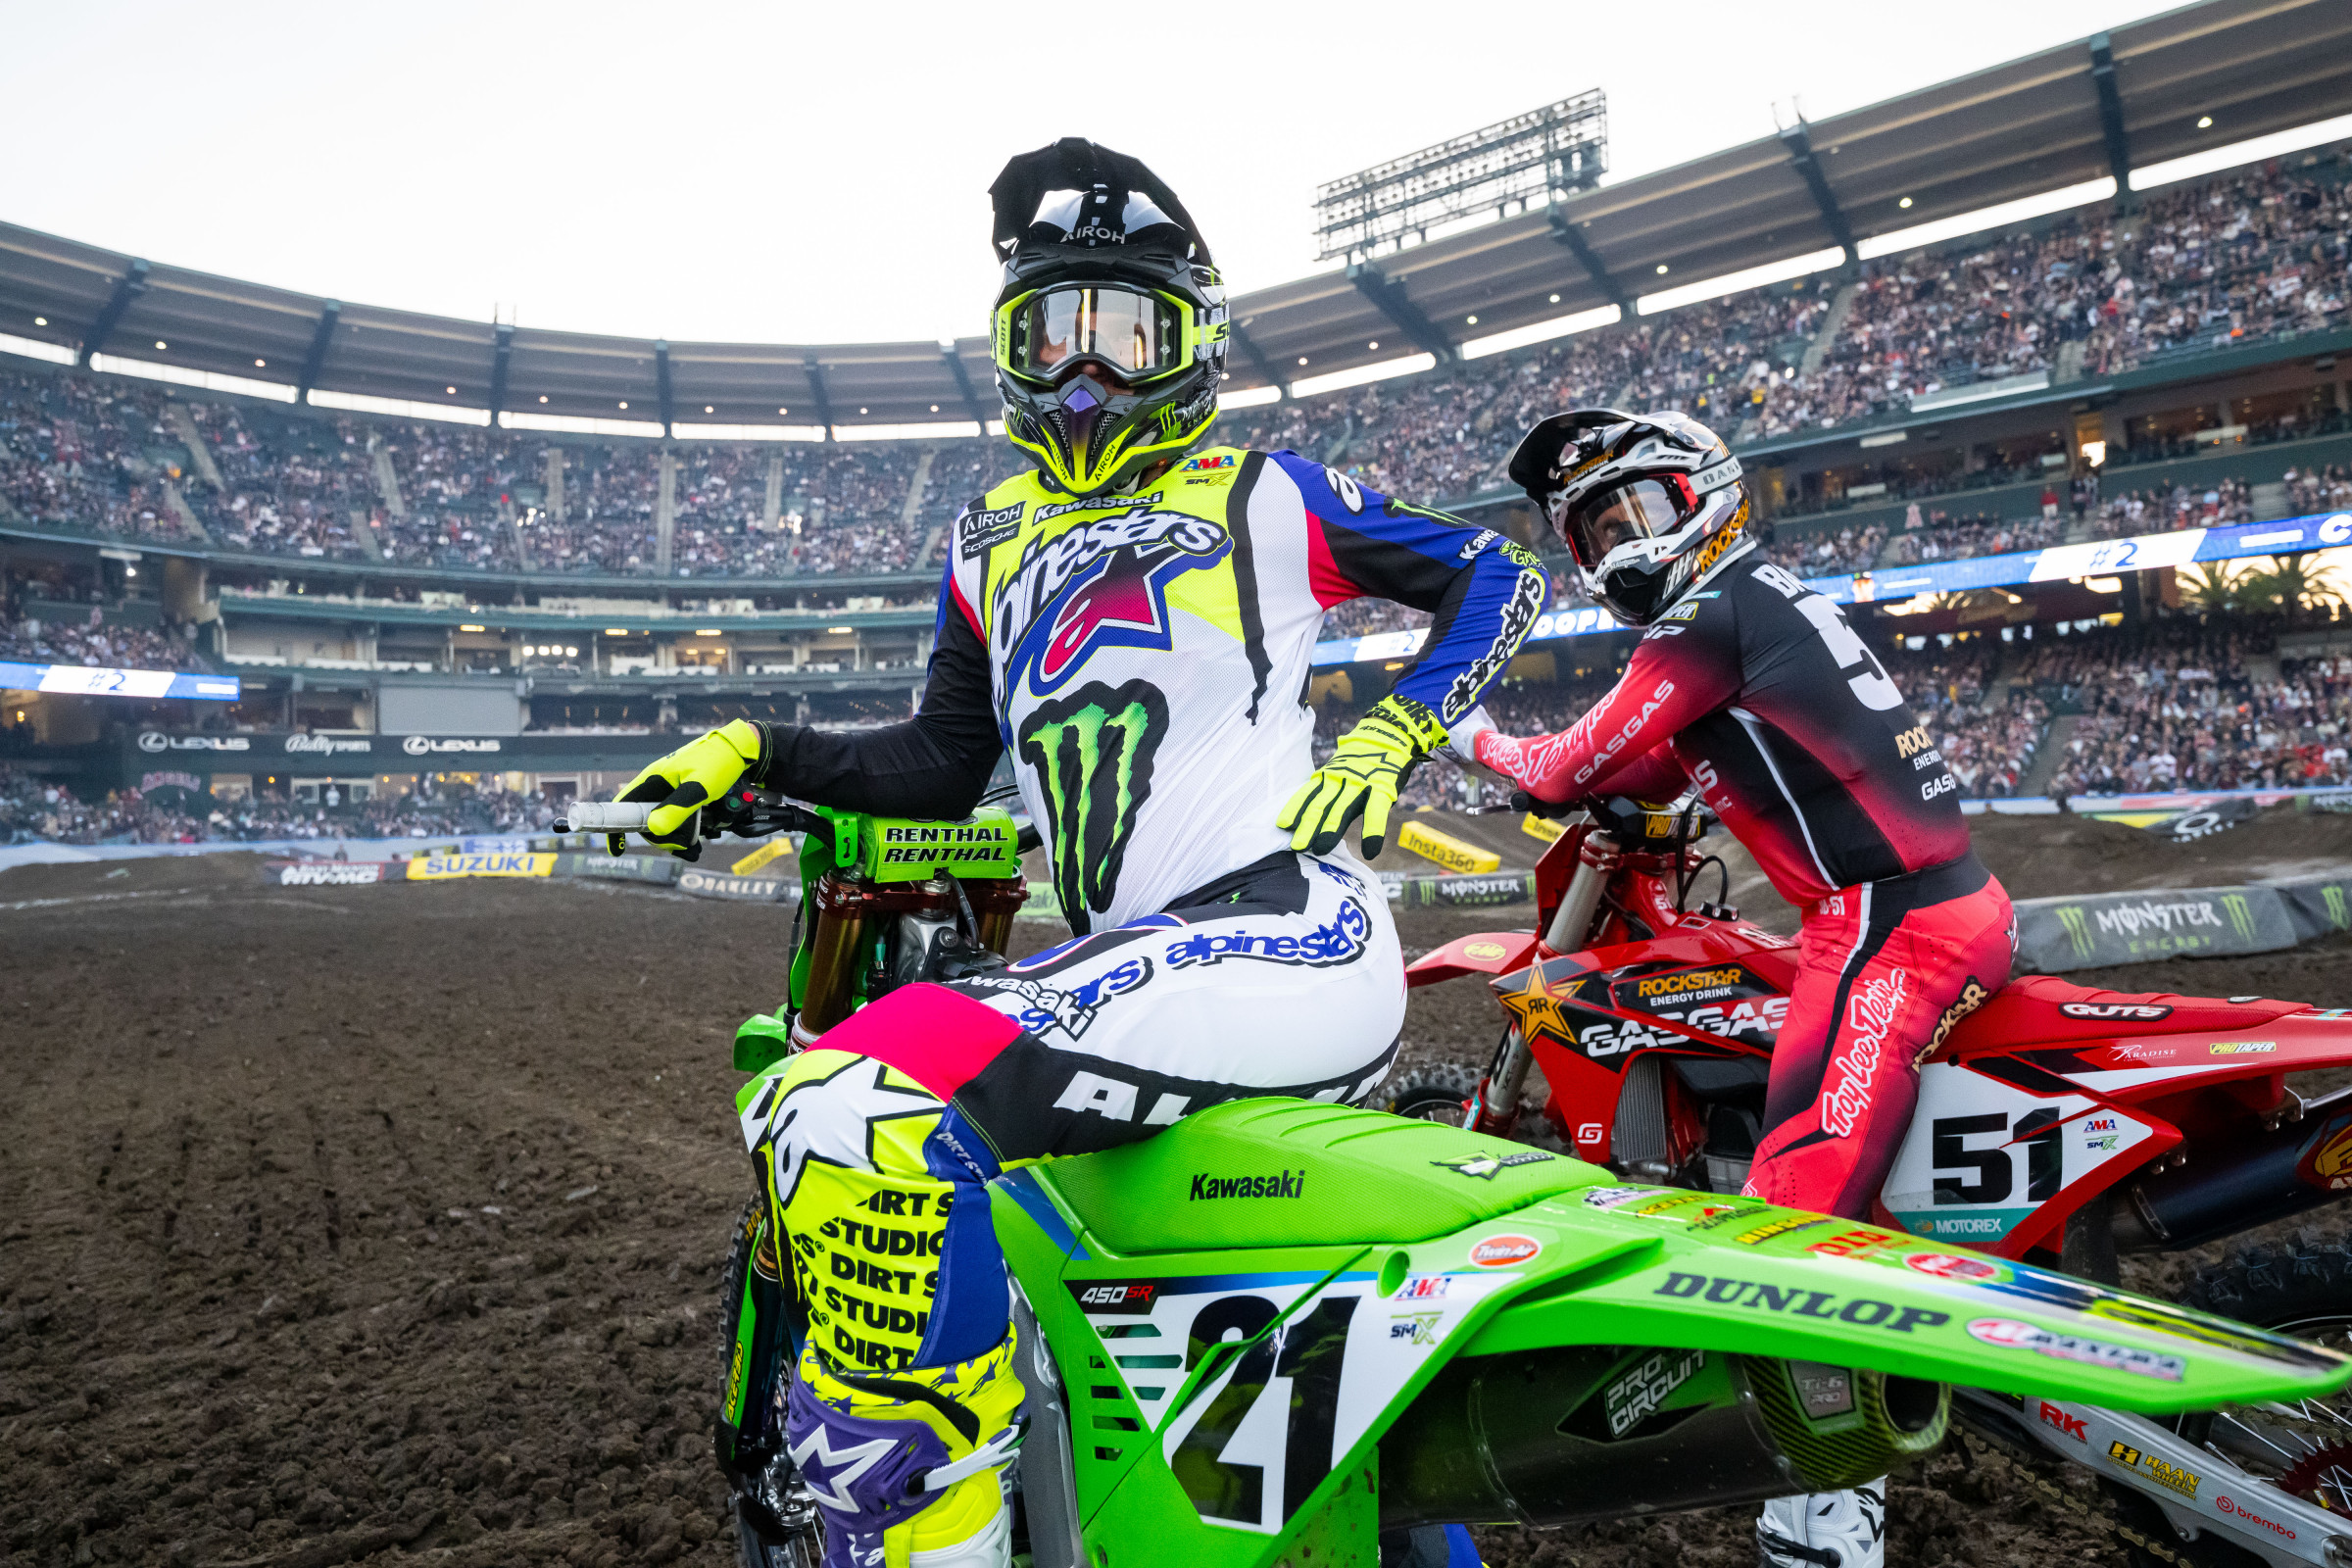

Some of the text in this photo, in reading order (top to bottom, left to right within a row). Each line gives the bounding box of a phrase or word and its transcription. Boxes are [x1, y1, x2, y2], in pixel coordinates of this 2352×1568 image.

[1059, 225, 1127, 245] AIROH
[1094, 443, 1117, 482] AIROH
[1179, 455, 1237, 472] AMA
[1184, 471, 1234, 487] SMX
[963, 503, 1023, 535] AIROH
[1032, 491, 1163, 523] Kawasaki
[2090, 540, 2139, 568] #2
[86, 672, 127, 692] #2
[170, 735, 251, 752] LEXUS
[429, 738, 502, 753] LEXUS
[1573, 678, 1676, 785] GASGAS
[884, 827, 1009, 844] RENTHAL
[424, 856, 535, 874] SUZUKI
[883, 847, 1006, 863] RENTHAL
[1408, 831, 1476, 872] Insta360
[702, 877, 778, 896] OAKLEY
[1441, 878, 1521, 898] MONSTER
[2094, 900, 2224, 936] MONSTER
[1164, 899, 1366, 969] alpinestars
[1638, 968, 1741, 998] ROCKSTAR
[1649, 986, 1733, 1007] ENERGY DRINK
[2063, 1002, 2168, 1019] GUTS
[1580, 997, 1790, 1057] GASGAS
[2083, 1118, 2118, 1133] AMA
[1932, 1105, 2063, 1206] 51
[1190, 1169, 1305, 1201] Kawasaki
[1936, 1218, 2002, 1235] MOTOREX
[1475, 1244, 1512, 1259] Twin
[830, 1250, 917, 1296] DIRT
[1395, 1277, 1451, 1301] AMA
[1653, 1270, 1951, 1334] DUNLOP
[824, 1285, 928, 1338] STUDI
[833, 1324, 915, 1371] DIRT
[1605, 1352, 1664, 1410] PRO
[1610, 1348, 1707, 1437] CIRCUIT
[1170, 1294, 1363, 1530] 21
[2038, 1400, 2089, 1441] RK
[2143, 1453, 2202, 1487] HAAN
[2151, 1469, 2197, 1494] WHEELS
[2237, 1505, 2297, 1541] brembo
